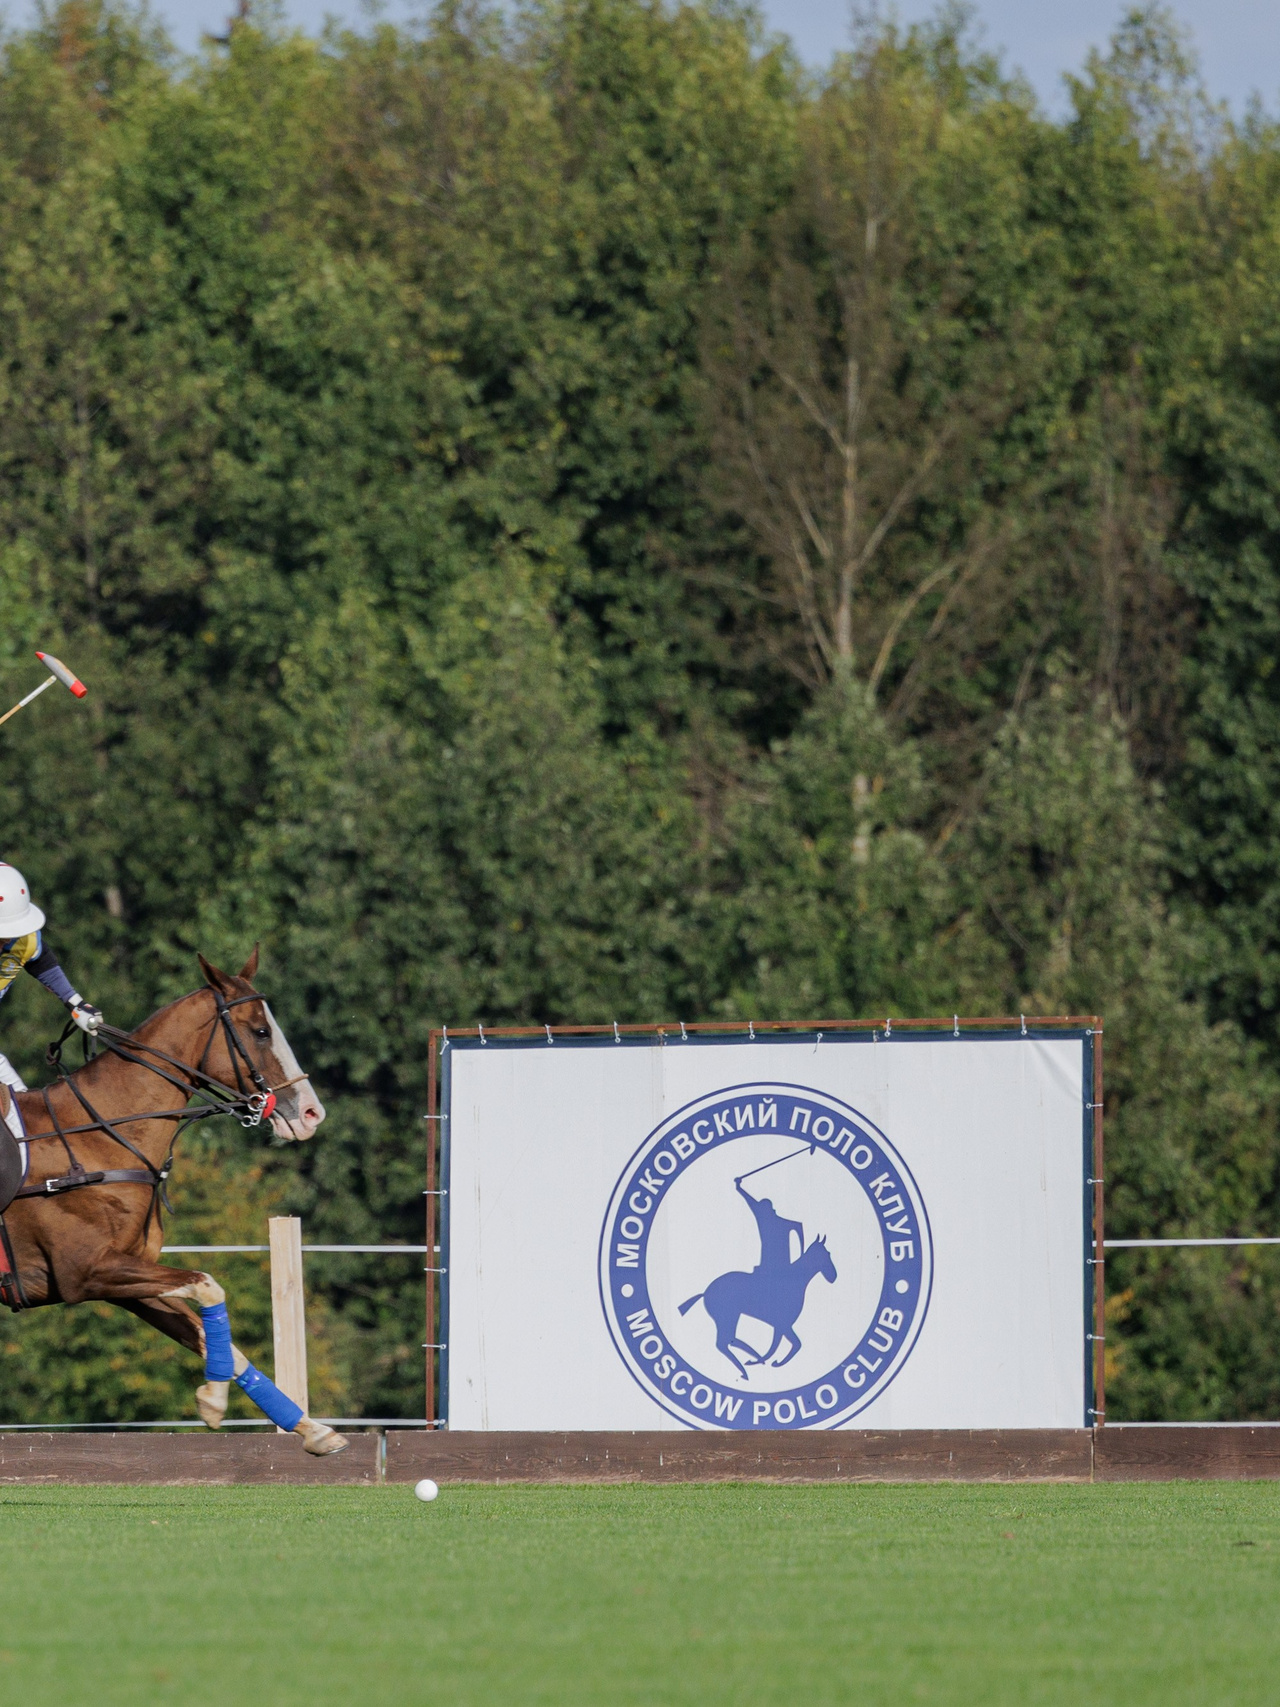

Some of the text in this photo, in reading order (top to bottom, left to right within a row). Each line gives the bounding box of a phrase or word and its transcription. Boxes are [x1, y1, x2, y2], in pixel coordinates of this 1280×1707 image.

[616, 1097, 914, 1268] МОСКОВСКИЙ ПОЛО КЛУБ
[625, 1306, 904, 1426] MOSCOW POLO CLUB
